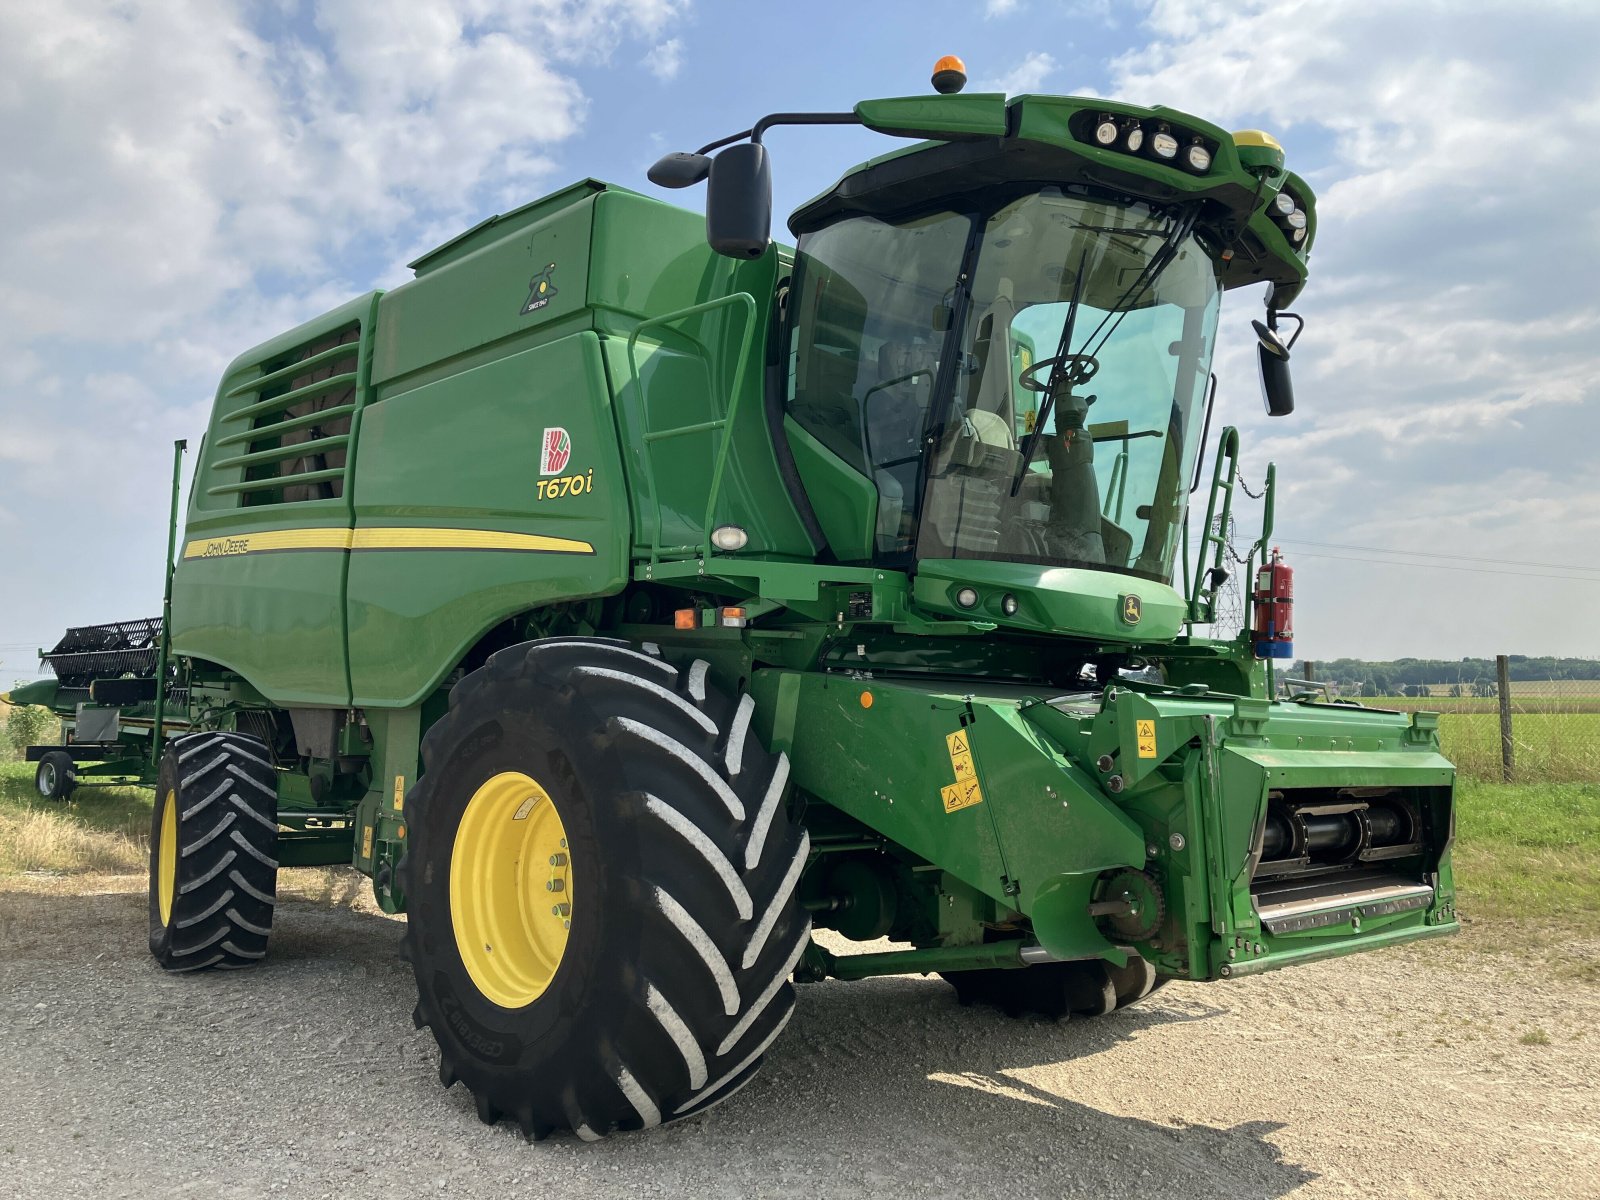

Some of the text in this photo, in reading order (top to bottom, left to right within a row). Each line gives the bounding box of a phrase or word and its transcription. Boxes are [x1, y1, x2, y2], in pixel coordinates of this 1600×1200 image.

[536, 468, 593, 500] T670i
[203, 539, 250, 556] JOHN DEERE
